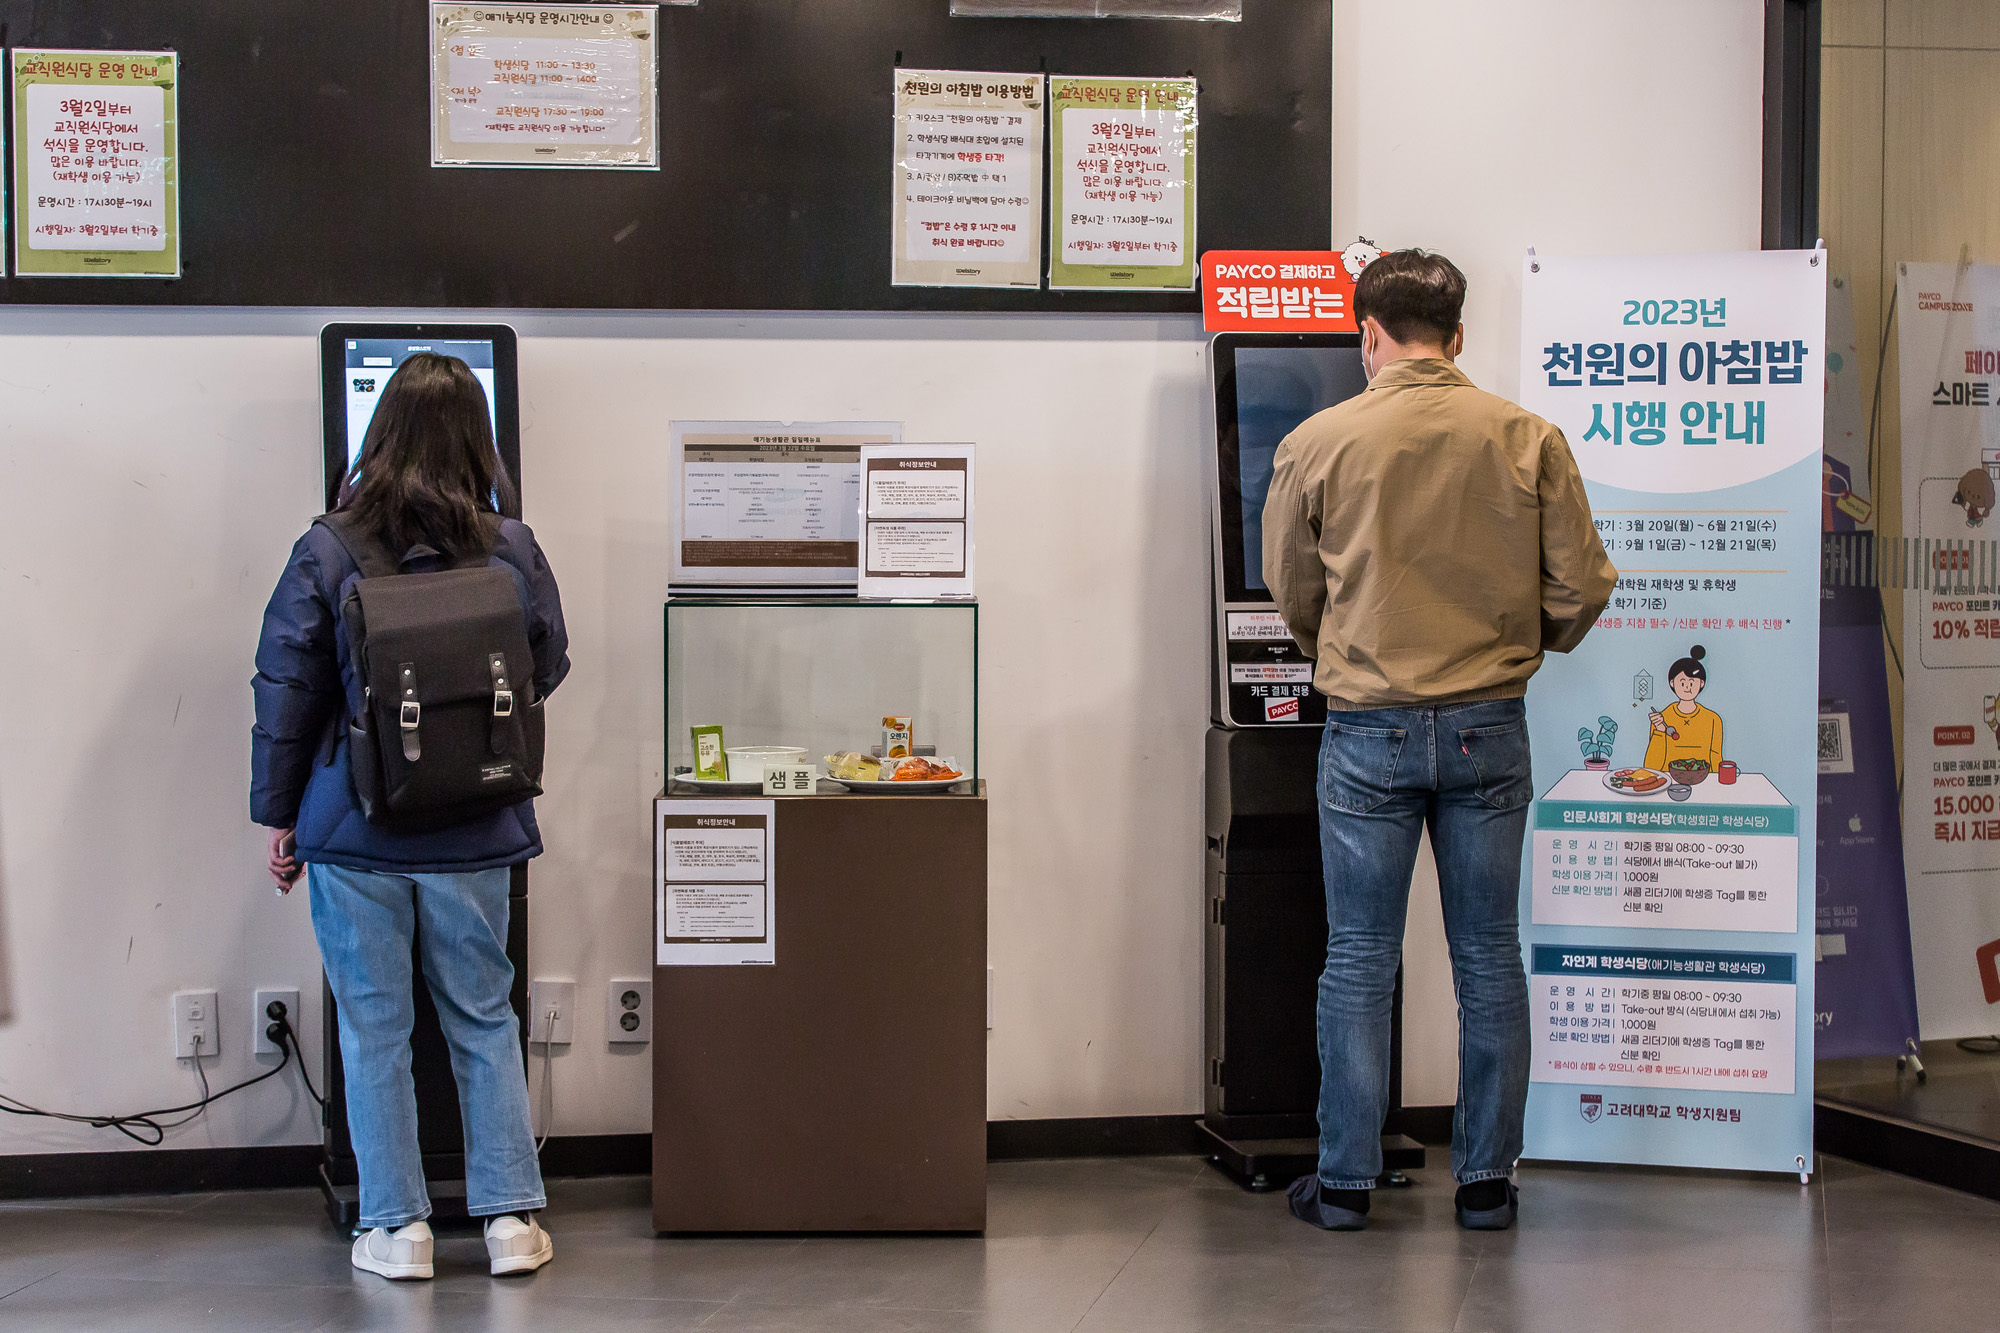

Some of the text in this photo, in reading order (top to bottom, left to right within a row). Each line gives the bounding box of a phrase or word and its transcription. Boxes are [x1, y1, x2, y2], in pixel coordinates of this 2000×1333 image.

[25, 61, 159, 79] 교직원식당 운영 안내
[494, 60, 529, 71] 학생식당
[904, 81, 1033, 99] 천원의 아침밥 이용방법
[1061, 87, 1121, 103] 교직원식당
[60, 99, 131, 117] 3월2일부터
[54, 121, 137, 135] 교직원식당에서
[1092, 123, 1155, 139] 3월2일부터
[44, 138, 148, 153] 석식을 운영합니다.
[51, 156, 70, 168] 많은
[75, 156, 94, 168] 이용
[958, 152, 982, 162] 학생증
[1077, 159, 1108, 173] 석식을
[1083, 176, 1121, 187] 많은 이용
[38, 197, 74, 207] 운영시간
[1216, 265, 1335, 279] PAYCO 결제하고
[1217, 287, 1344, 318] 적립받는
[1919, 302, 1951, 311] CAMPUS
[1623, 298, 1725, 327] 2023년
[1542, 340, 1808, 386] 천원의 아침밥
[1933, 382, 1989, 406] 스마트
[1582, 401, 1765, 445] 시행 안내
[1626, 520, 1776, 532] 3월 20일(월) 6월 21일(수)
[1626, 539, 1776, 551] 9월 1일(금) 12월 21일(목)
[1651, 579, 1736, 591] 재학생 휴학생
[1615, 598, 1636, 609] 학기
[1641, 598, 1666, 610] 기준)
[1933, 602, 1963, 611] PAYCO
[1627, 618, 1646, 628] 지참
[1650, 618, 1669, 628] 필수
[1702, 619, 1721, 629] 확인
[1739, 619, 1758, 629] 배식
[1933, 620, 1970, 639] 10%
[1251, 686, 1309, 696] 카드 결제 전용
[890, 731, 907, 740] 오렌지
[1934, 777, 1965, 788] PAYCO
[1934, 795, 1994, 815] 15,000
[1564, 811, 1769, 827] 인문사회계 학생식당)
[1935, 821, 1965, 842] 즉시
[1625, 841, 1744, 854] 학기중 평일 08:00 09:30
[1624, 857, 1661, 866] 식당에서
[1624, 872, 1658, 882] 1,000원
[1645, 888, 1682, 898] 리더기에
[1685, 889, 1712, 899] 학생증
[1623, 902, 1662, 913] 신분 확인
[1562, 955, 1765, 974] 자연계 학생식당)
[1622, 989, 1741, 1003] 학기중 평일 08:00 09:30
[1622, 1004, 1664, 1015] Take-out
[1667, 1006, 1684, 1015] 방식
[1740, 1009, 1756, 1019] 섭취
[1622, 1020, 1656, 1030] 1,000원
[1643, 1036, 1679, 1046] 리더기에
[1683, 1037, 1710, 1048] 학생증
[1621, 1050, 1660, 1061] 신분 확인
[1607, 1104, 1740, 1122] 고려대학교 학생지원팀
